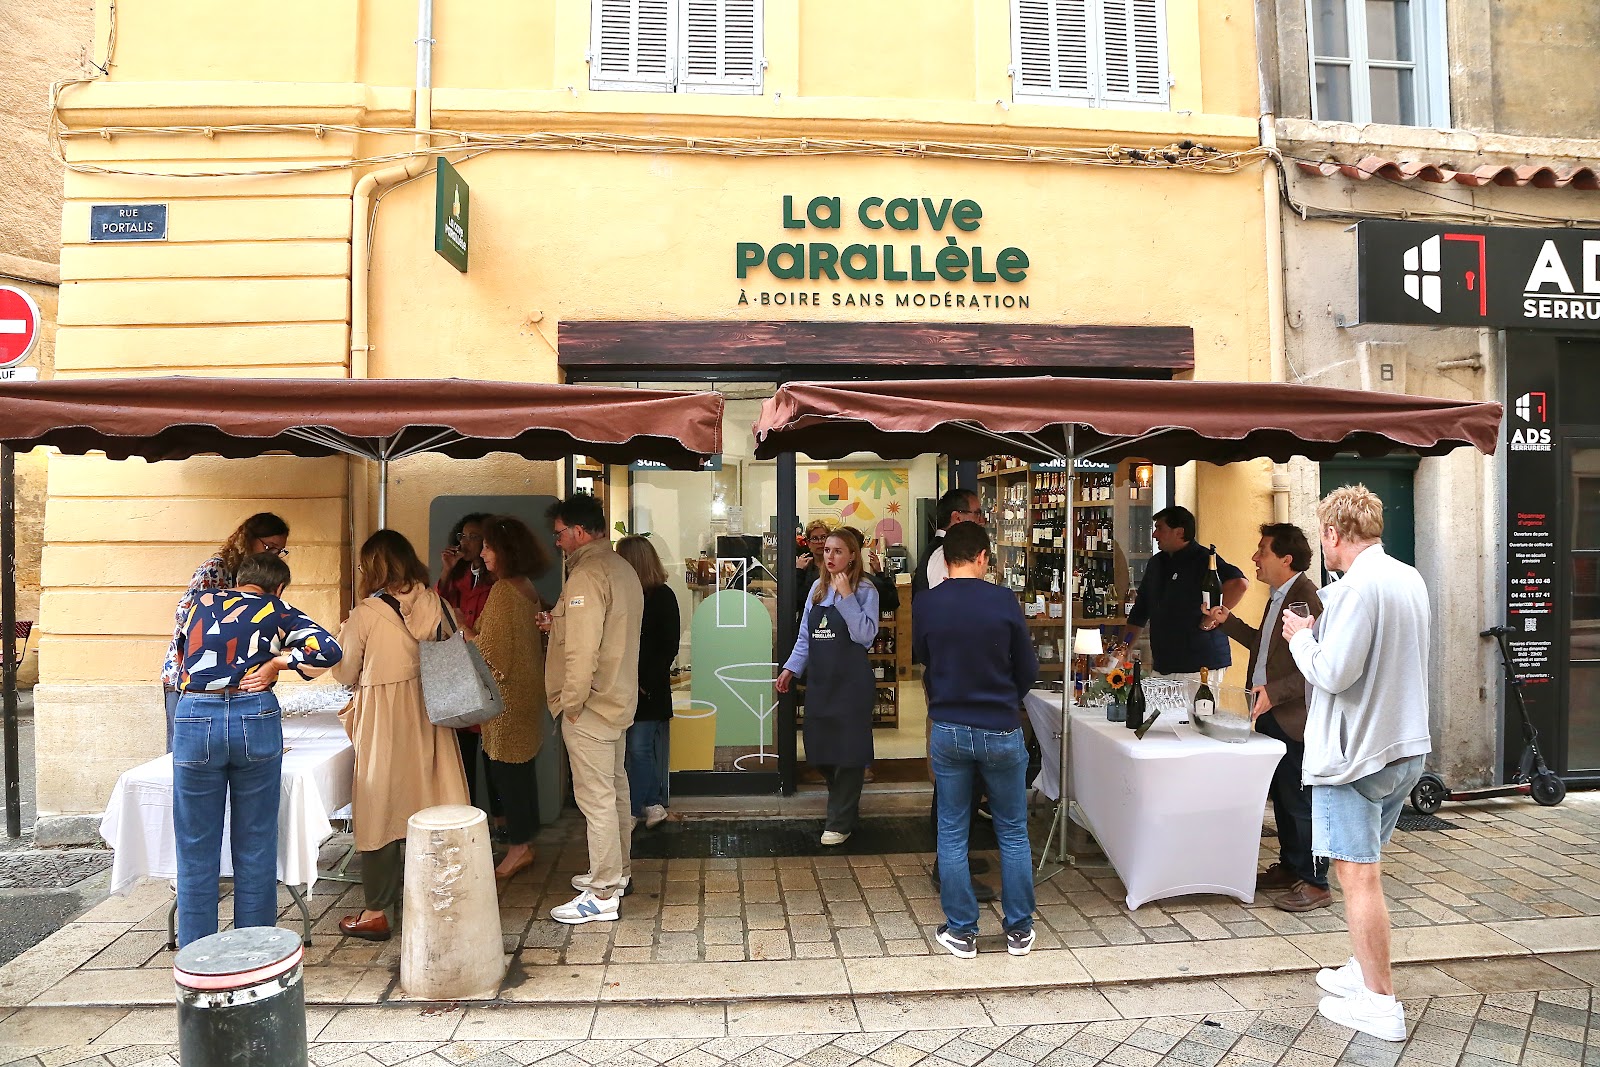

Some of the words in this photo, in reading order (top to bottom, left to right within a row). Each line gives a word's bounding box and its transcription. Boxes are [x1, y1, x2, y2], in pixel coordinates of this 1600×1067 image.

[119, 209, 138, 218] RUE
[102, 221, 154, 233] PORTALIS
[760, 292, 820, 306] BOIRE
[832, 293, 884, 307] SANS
[896, 291, 1030, 309] MODÉRATION
[0, 370, 16, 380] UF
[1381, 363, 1393, 381] 8
[1511, 428, 1552, 444] ADS
